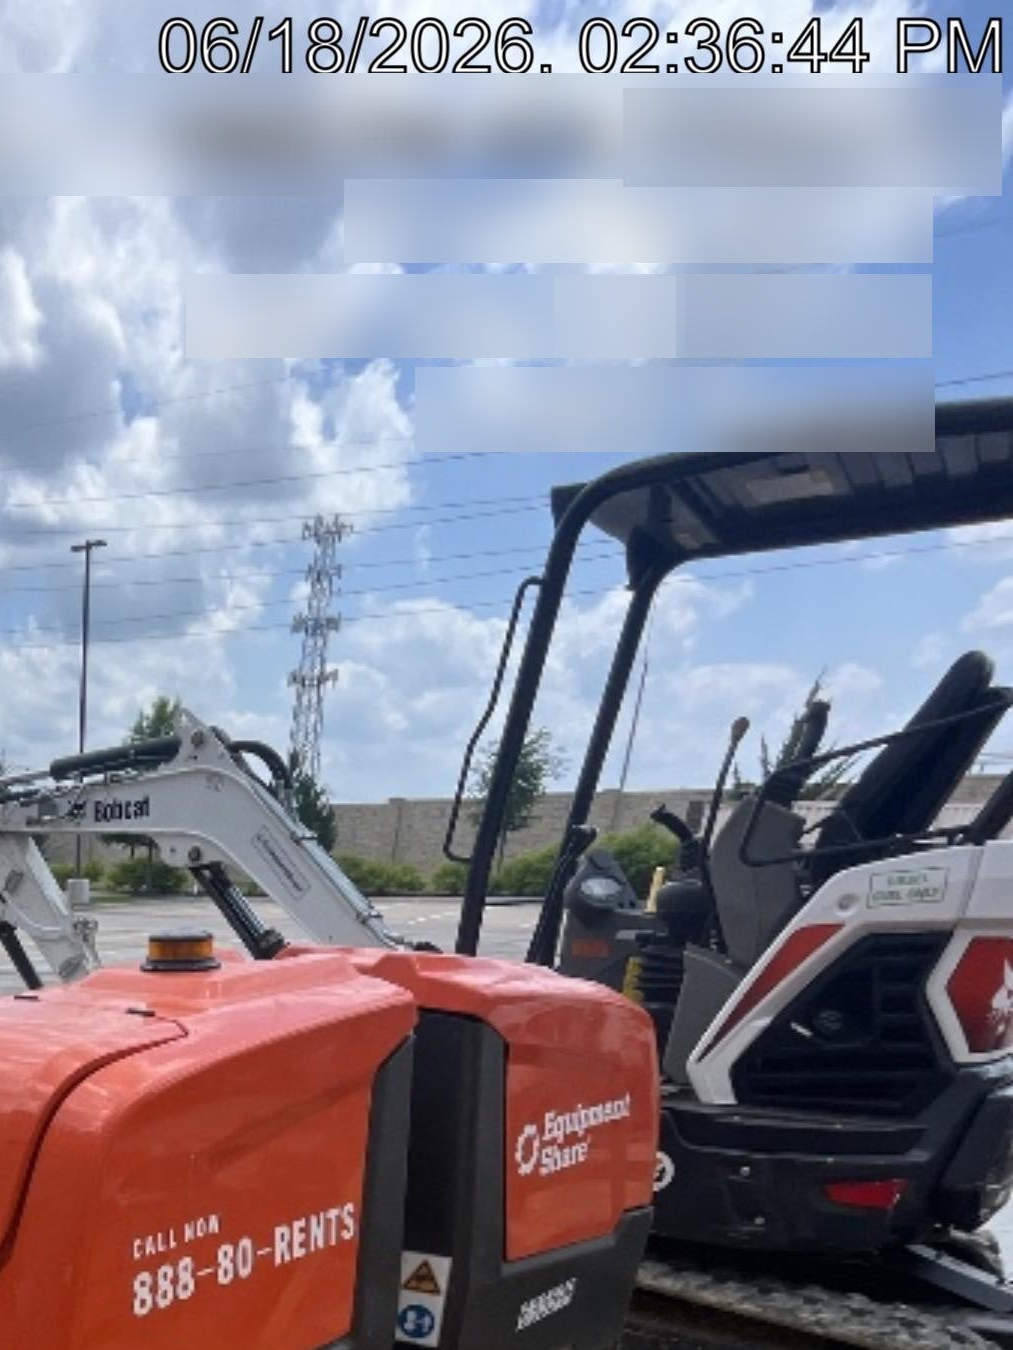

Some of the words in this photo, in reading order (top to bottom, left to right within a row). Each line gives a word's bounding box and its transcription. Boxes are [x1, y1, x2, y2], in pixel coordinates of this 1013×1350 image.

[94, 796, 150, 822] Bobcat
[542, 1092, 631, 1143] Equipment
[539, 1140, 588, 1177] Share
[133, 1229, 177, 1259] CALL
[133, 1202, 355, 1317] 888-80-RENTS
